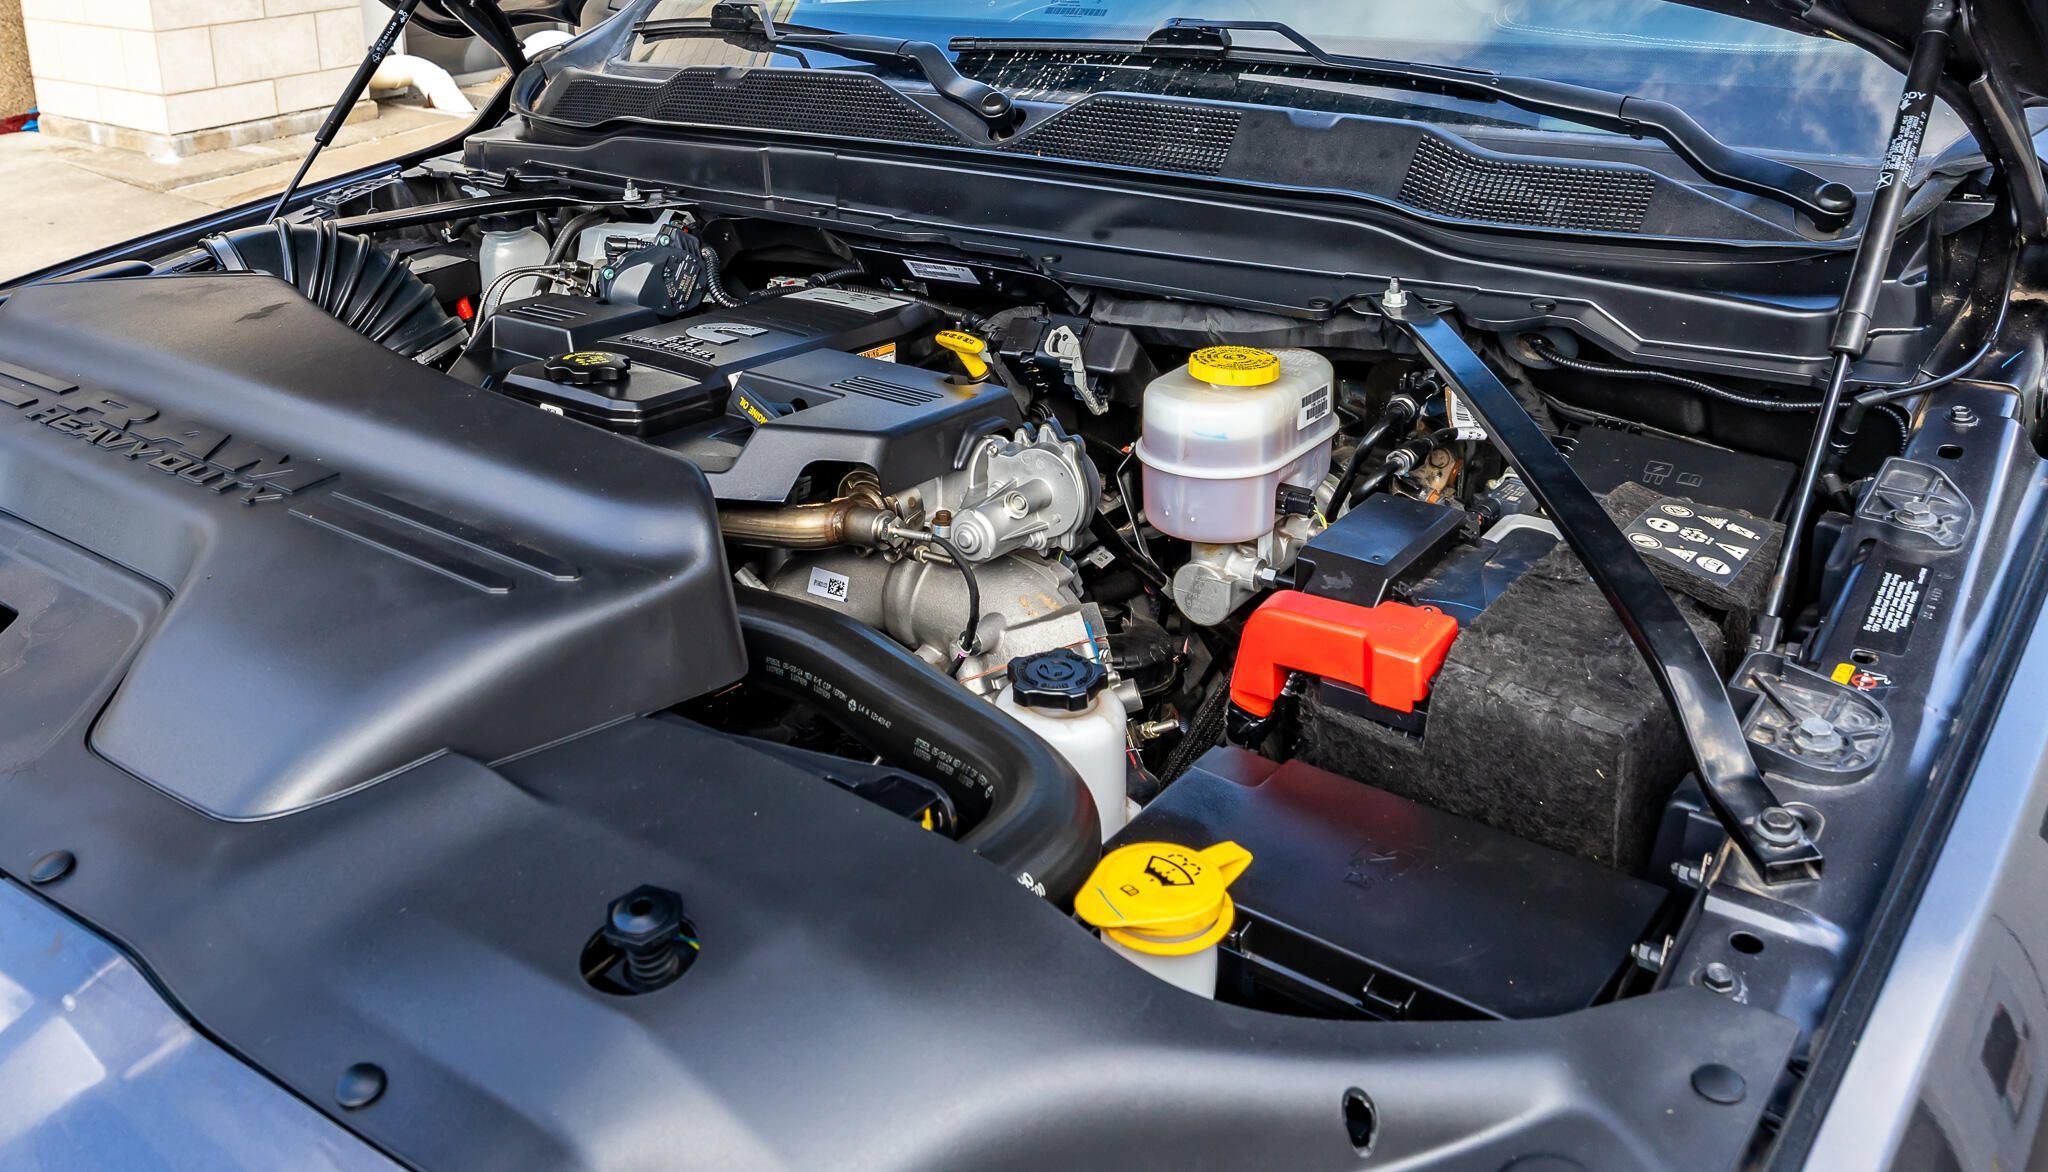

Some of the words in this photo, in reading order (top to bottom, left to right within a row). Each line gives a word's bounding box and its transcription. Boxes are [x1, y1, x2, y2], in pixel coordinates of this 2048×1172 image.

[376, 21, 397, 51] STABILUS
[25, 408, 163, 459] HEAVY
[148, 453, 282, 504] DUTY
